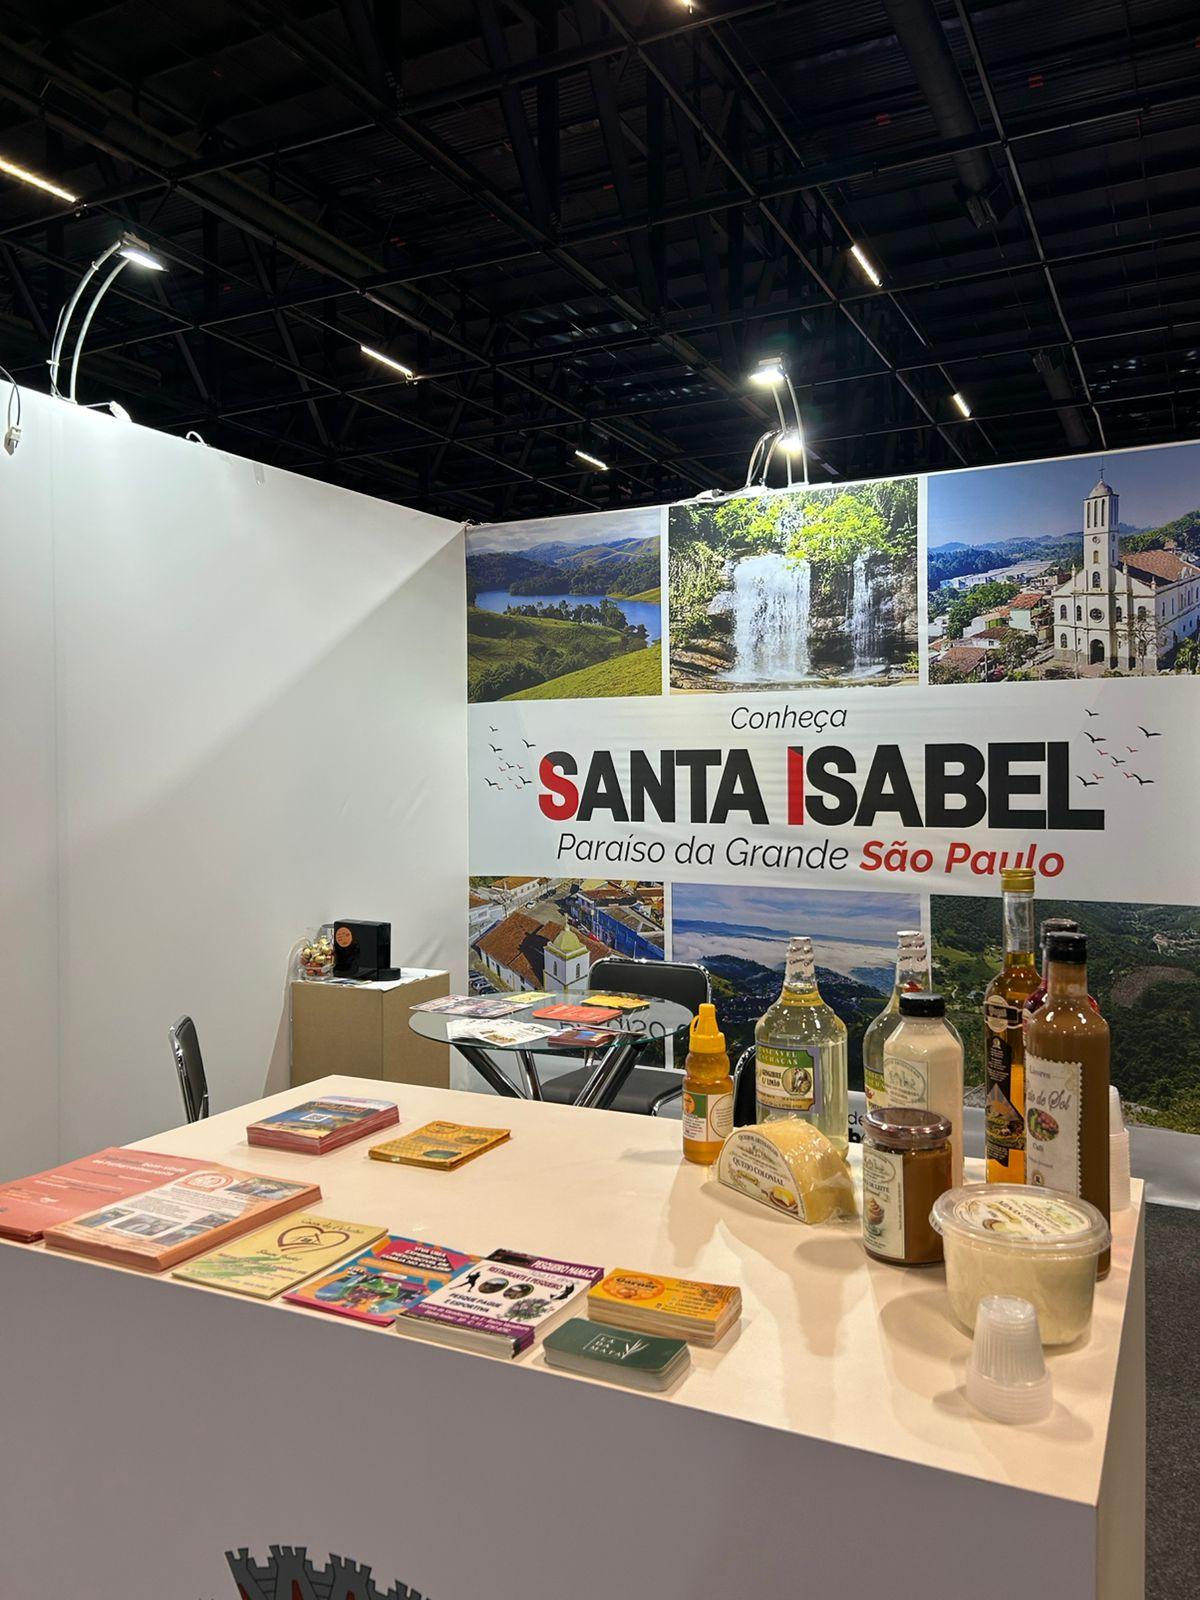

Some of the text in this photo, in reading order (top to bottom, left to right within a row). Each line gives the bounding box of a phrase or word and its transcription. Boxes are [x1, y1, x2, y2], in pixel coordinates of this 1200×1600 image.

[732, 705, 847, 733] Conheça
[539, 741, 1105, 830] SANTA ISABEL
[558, 834, 1065, 878] Paraíso da Grande São Paulo
[753, 1167, 785, 1187] COLONIAL
[488, 1266, 526, 1281] RESTAURANTE
[529, 1277, 564, 1290] PESQUEIRO
